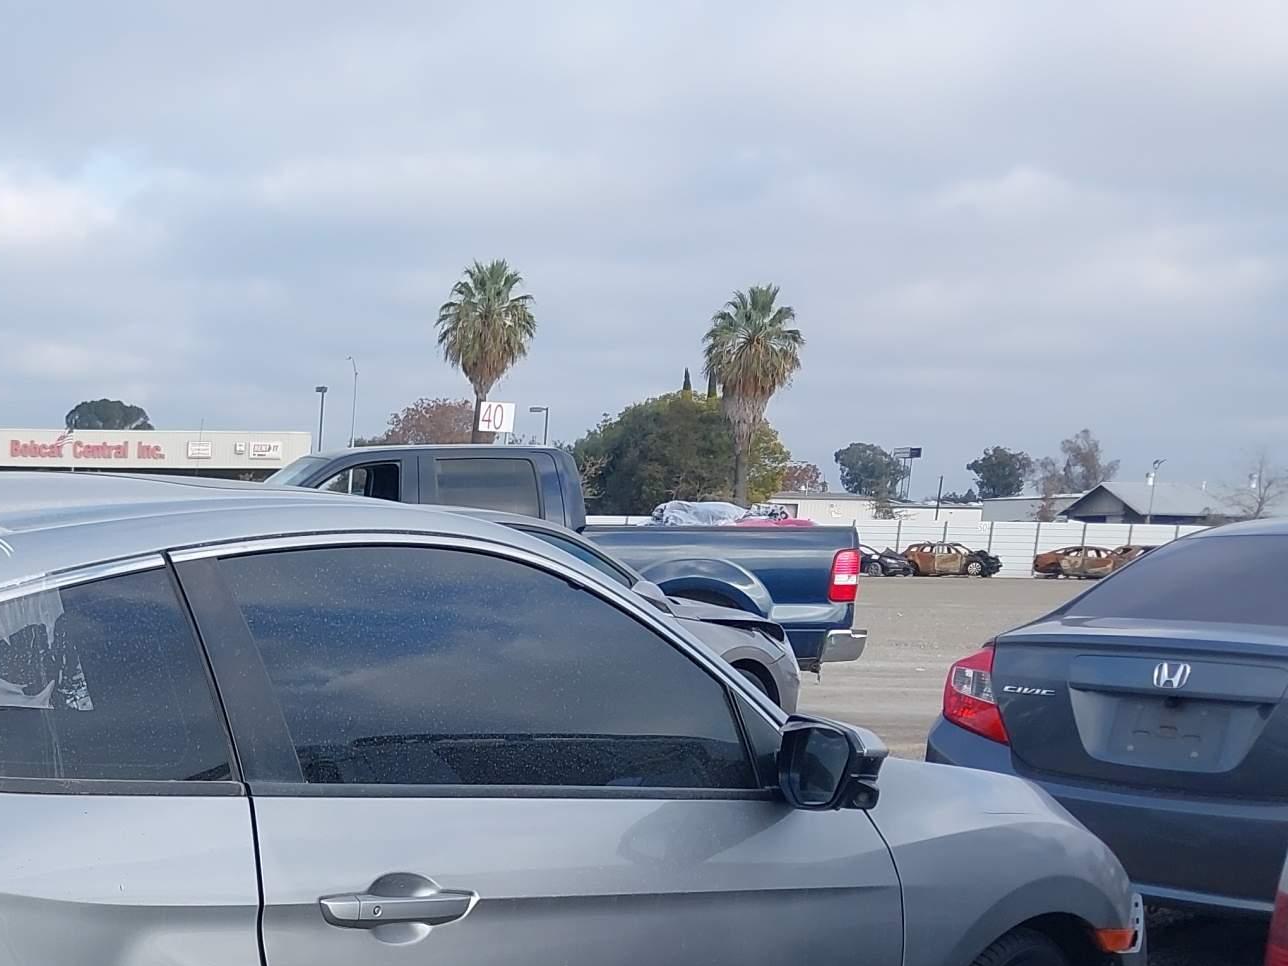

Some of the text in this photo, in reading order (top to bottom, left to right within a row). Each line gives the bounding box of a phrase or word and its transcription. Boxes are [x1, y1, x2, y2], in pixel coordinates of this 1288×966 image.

[481, 403, 504, 430] 40
[10, 439, 63, 457] Bobcat
[73, 440, 129, 459] Central
[136, 440, 167, 459] Inc.
[1003, 685, 1056, 696] CIVIC
